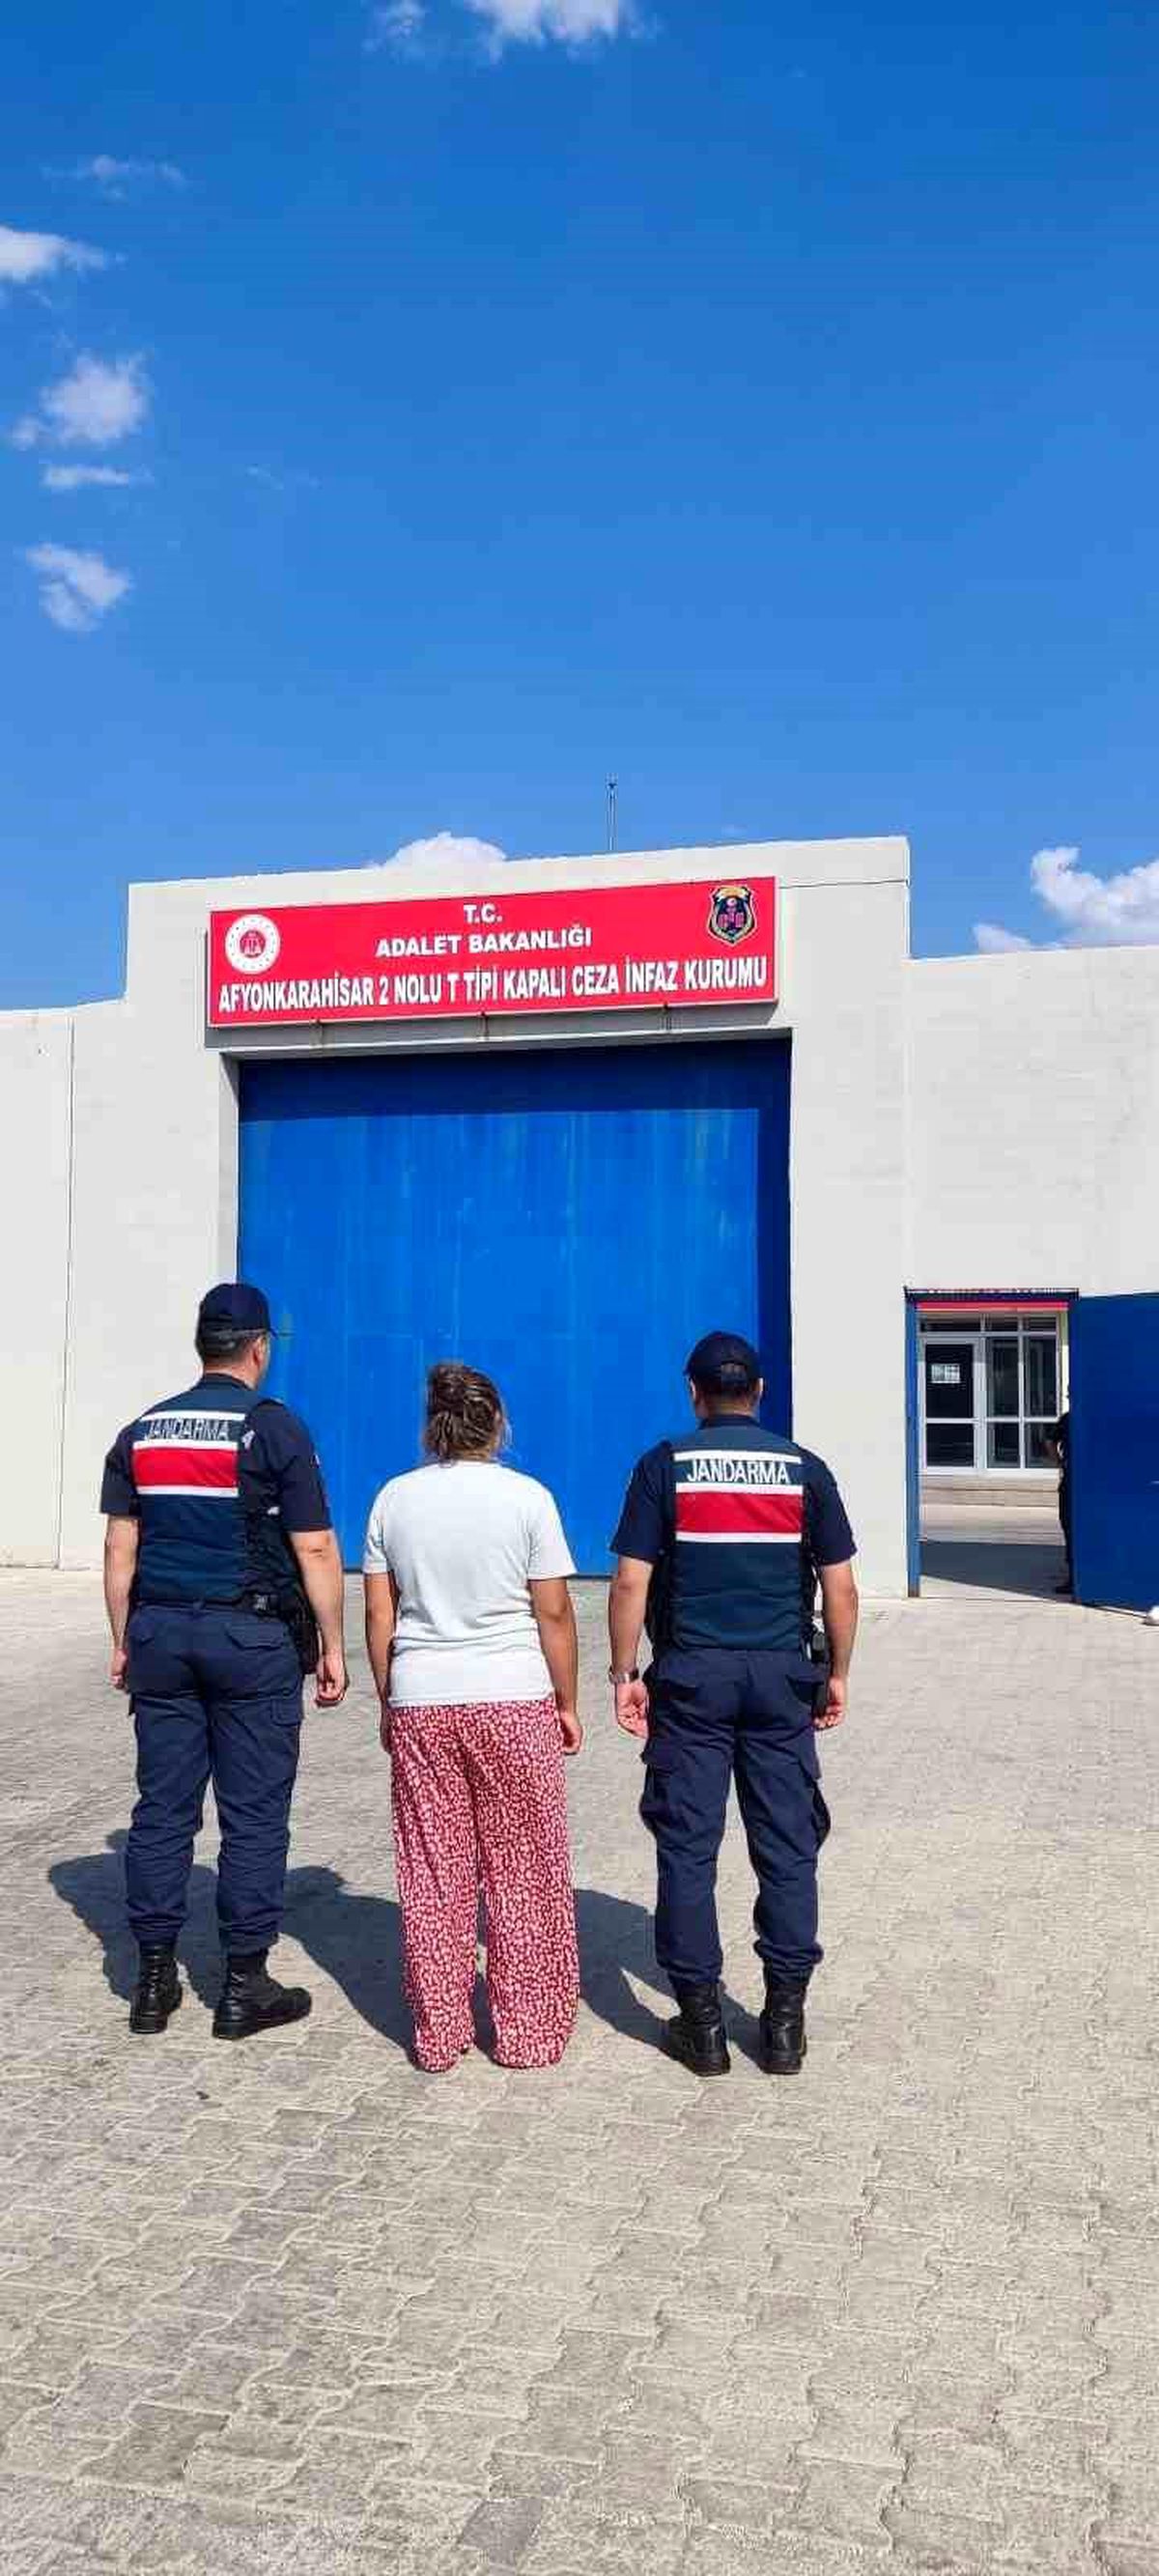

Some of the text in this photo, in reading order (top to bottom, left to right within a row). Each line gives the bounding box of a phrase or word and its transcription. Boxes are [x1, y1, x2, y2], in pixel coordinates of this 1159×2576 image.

[463, 903, 502, 924] T.C.
[375, 922, 592, 957] ADALET BAKANLIĞI
[218, 954, 768, 1012] AFYONKARAHİSAR 2 NOLU T TİPİ KAPALI CEZA İNFAZ KURUMU
[144, 1418, 230, 1441] JANDARMA
[687, 1458, 790, 1485] JANDARMA
